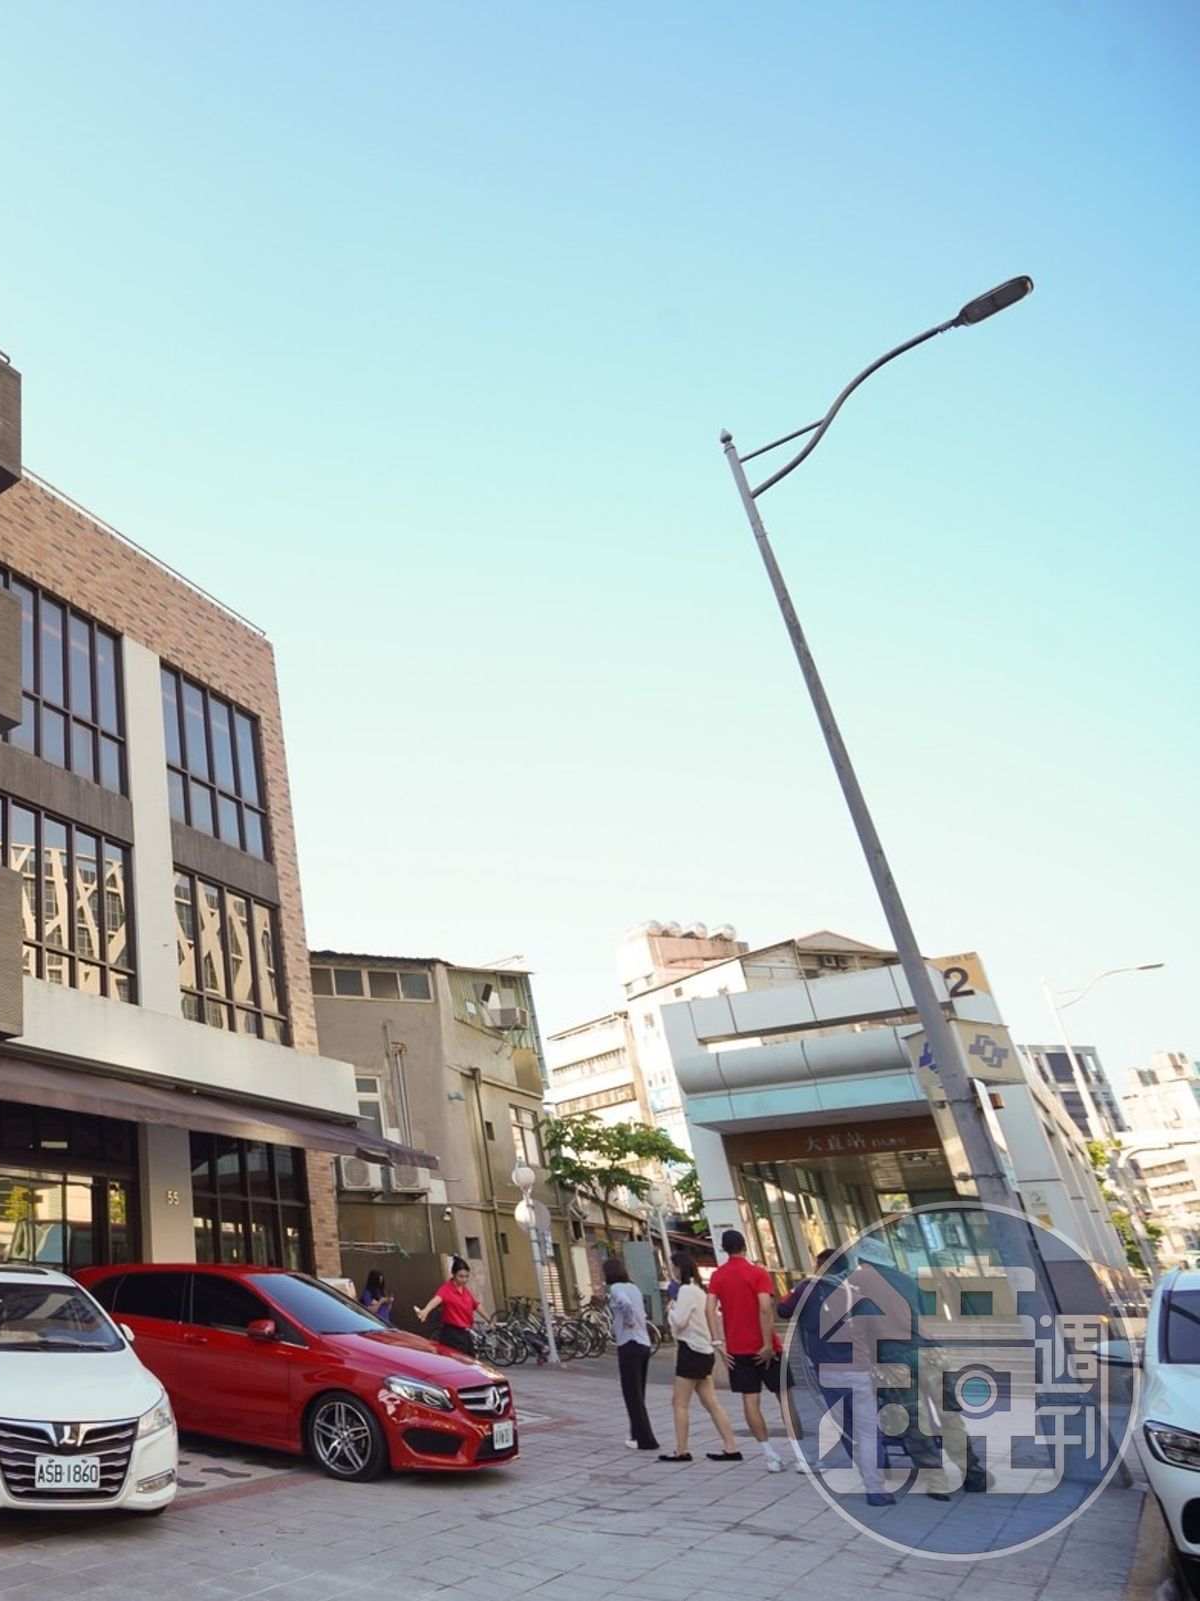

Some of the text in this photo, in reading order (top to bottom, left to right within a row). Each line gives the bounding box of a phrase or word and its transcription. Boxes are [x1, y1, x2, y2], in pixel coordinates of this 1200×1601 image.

[943, 967, 975, 998] 2
[806, 1132, 867, 1151] 大直站
